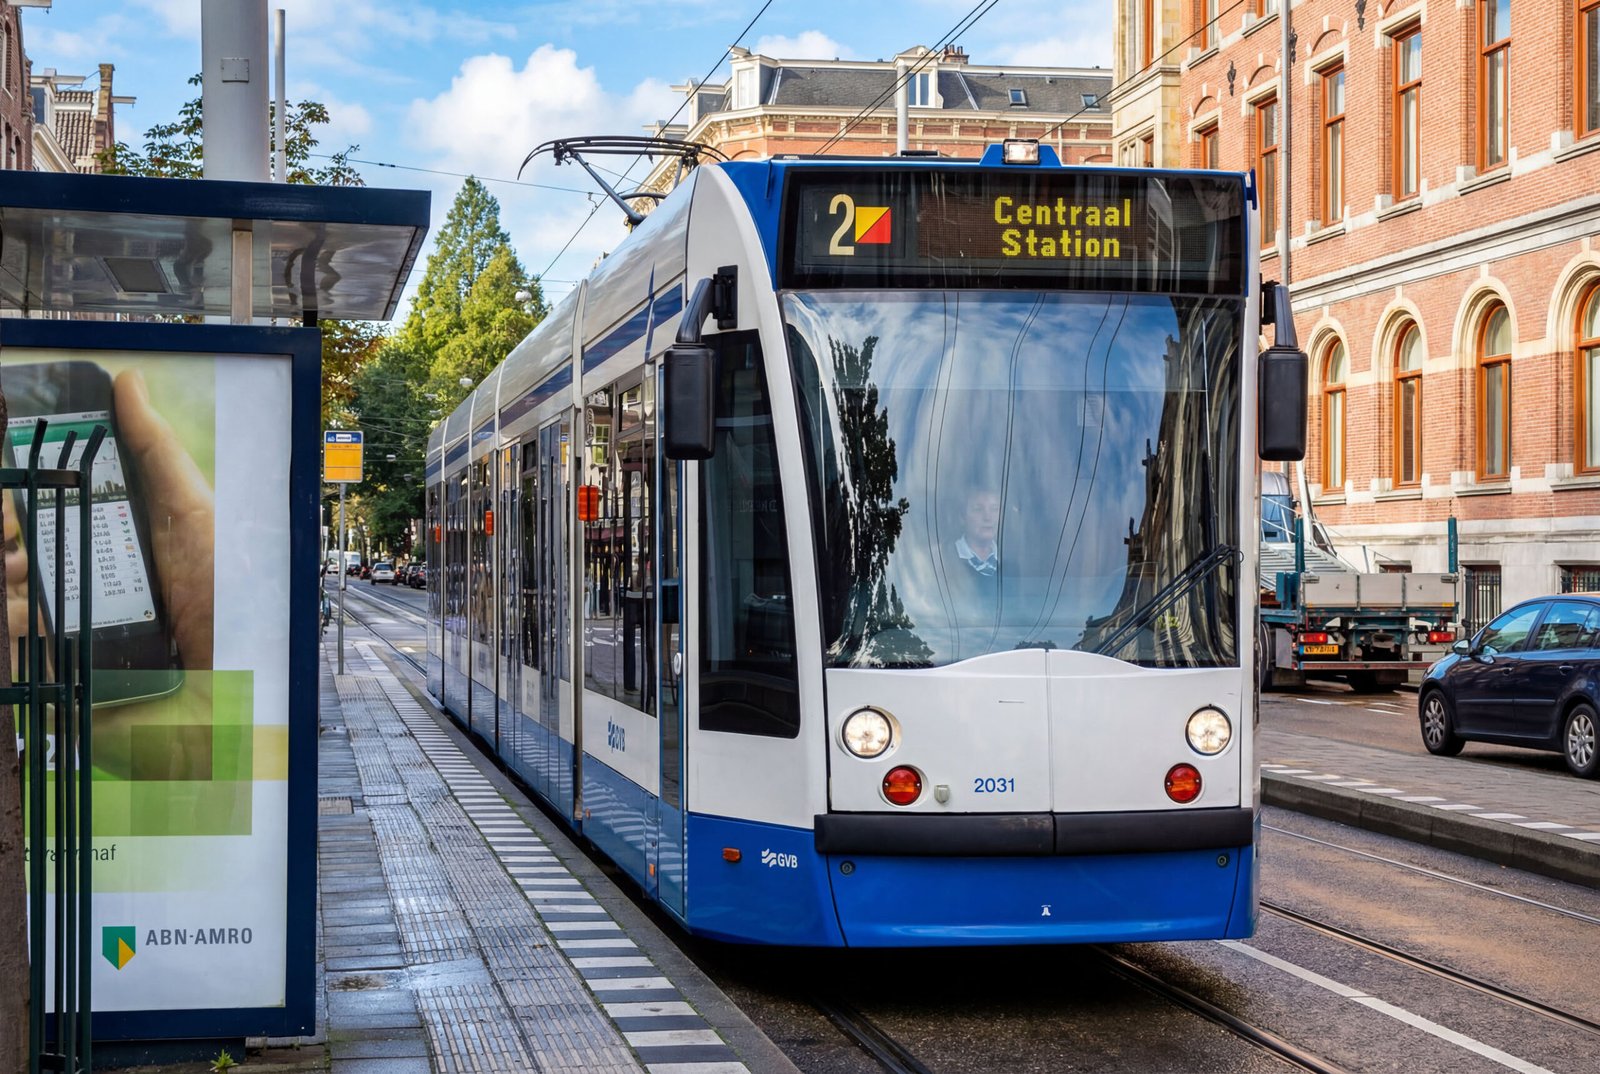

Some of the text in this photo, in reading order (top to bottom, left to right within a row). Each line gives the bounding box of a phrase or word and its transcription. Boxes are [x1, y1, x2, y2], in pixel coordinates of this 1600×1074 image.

[828, 193, 855, 256] 2
[994, 196, 1131, 226] Centraal
[1001, 228, 1120, 258] Station
[974, 777, 1015, 793] 2031
[777, 852, 798, 869] GVB
